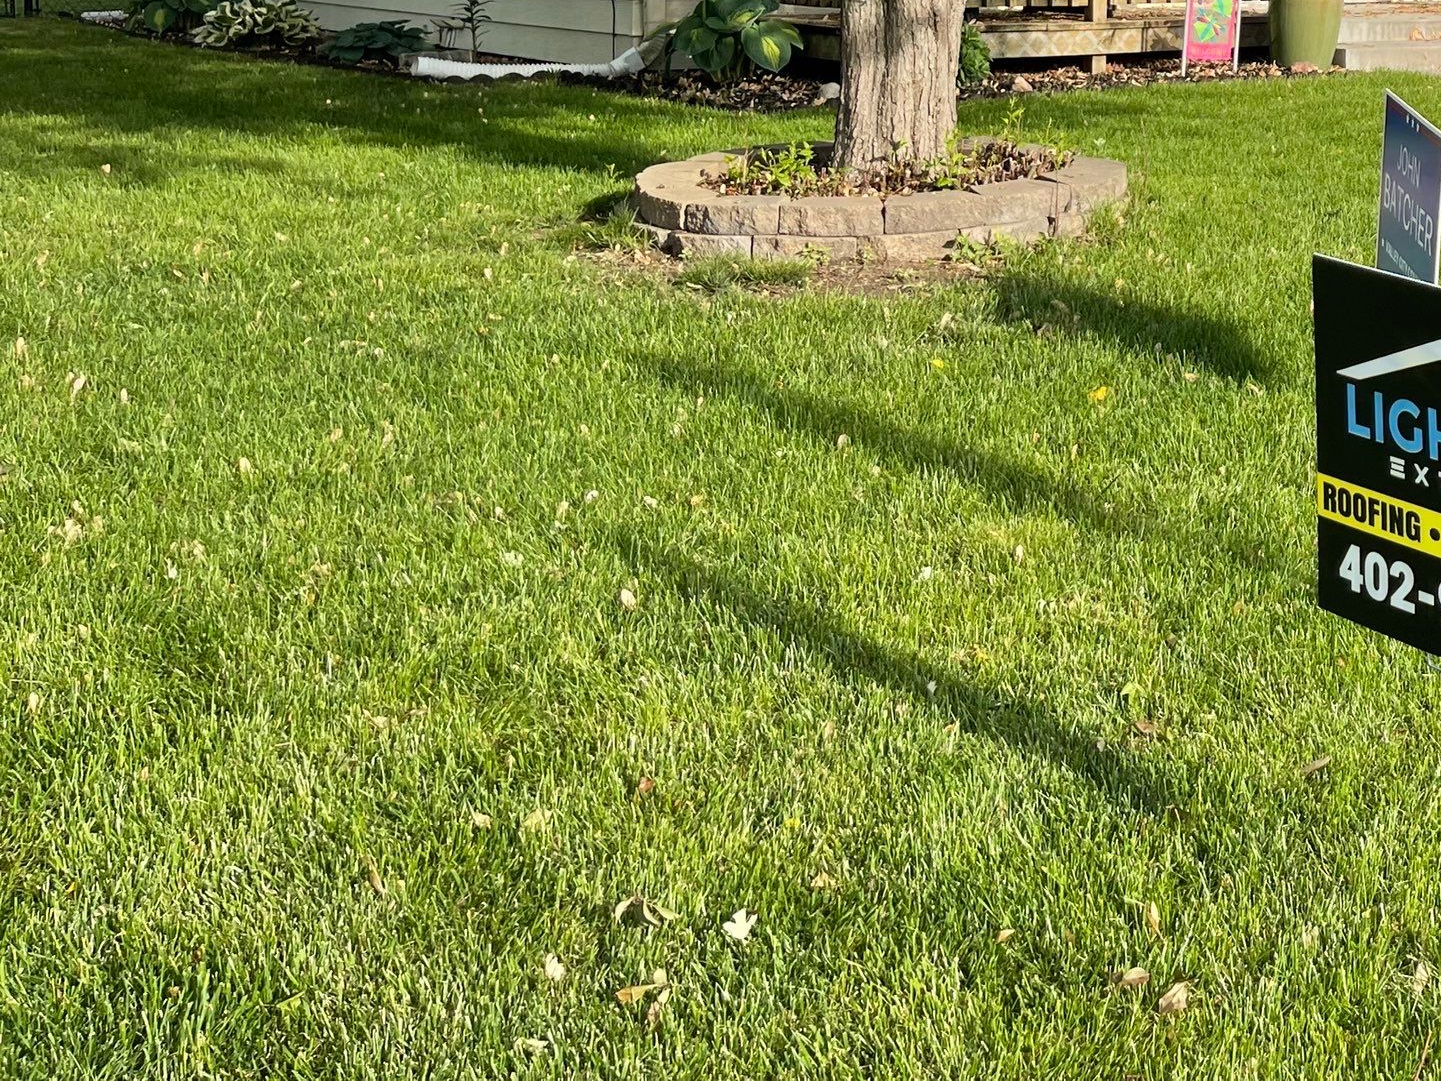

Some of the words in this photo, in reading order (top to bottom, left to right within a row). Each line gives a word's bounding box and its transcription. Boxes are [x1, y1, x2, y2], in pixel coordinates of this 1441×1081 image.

[1397, 144, 1421, 189] JOHN
[1384, 172, 1432, 256] BATCHER
[1323, 481, 1421, 543] ROOFING
